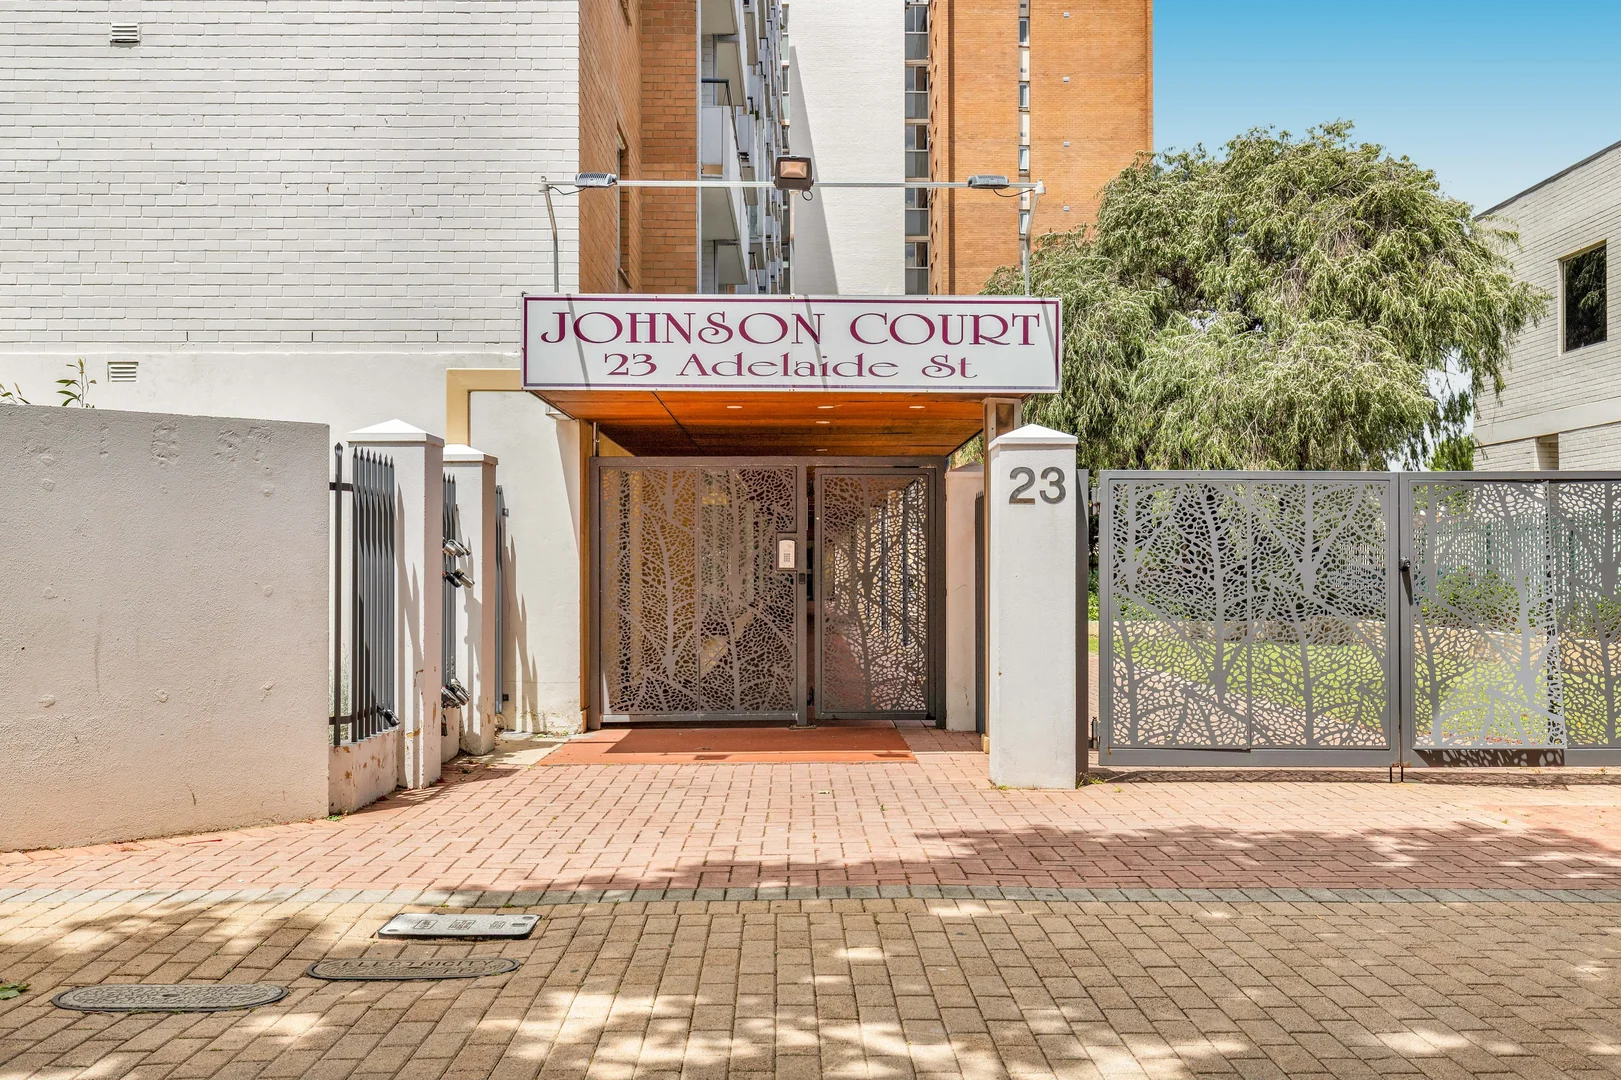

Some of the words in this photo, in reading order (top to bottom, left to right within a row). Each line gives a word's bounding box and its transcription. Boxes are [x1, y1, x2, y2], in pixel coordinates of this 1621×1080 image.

[540, 311, 825, 345] JOHNSON
[849, 312, 1041, 346] COURT
[604, 353, 658, 377] 23
[675, 352, 899, 378] Adelaide
[920, 354, 979, 378] St
[1008, 466, 1067, 505] 23
